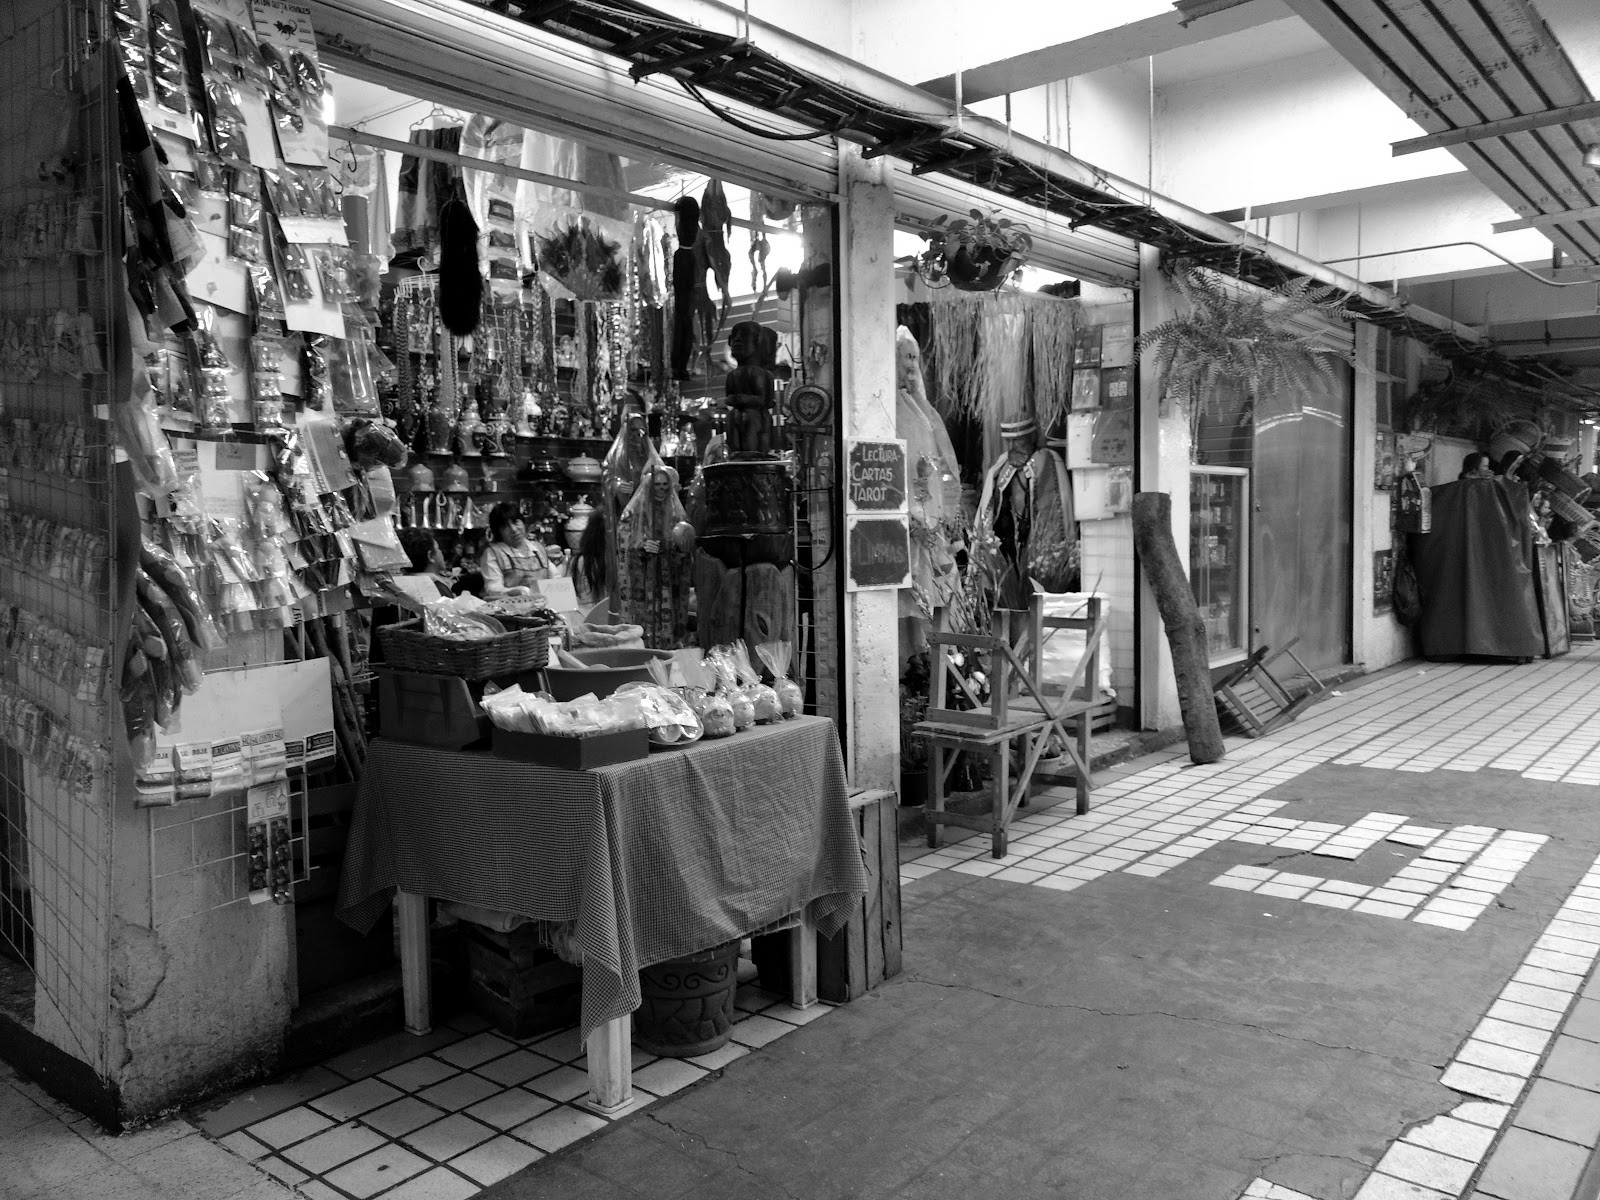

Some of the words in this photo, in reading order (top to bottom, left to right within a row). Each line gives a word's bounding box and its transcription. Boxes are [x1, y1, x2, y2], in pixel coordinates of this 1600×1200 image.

[862, 445, 899, 463] LECTURA
[851, 462, 893, 482] CARTAS
[852, 482, 887, 501] TAROT
